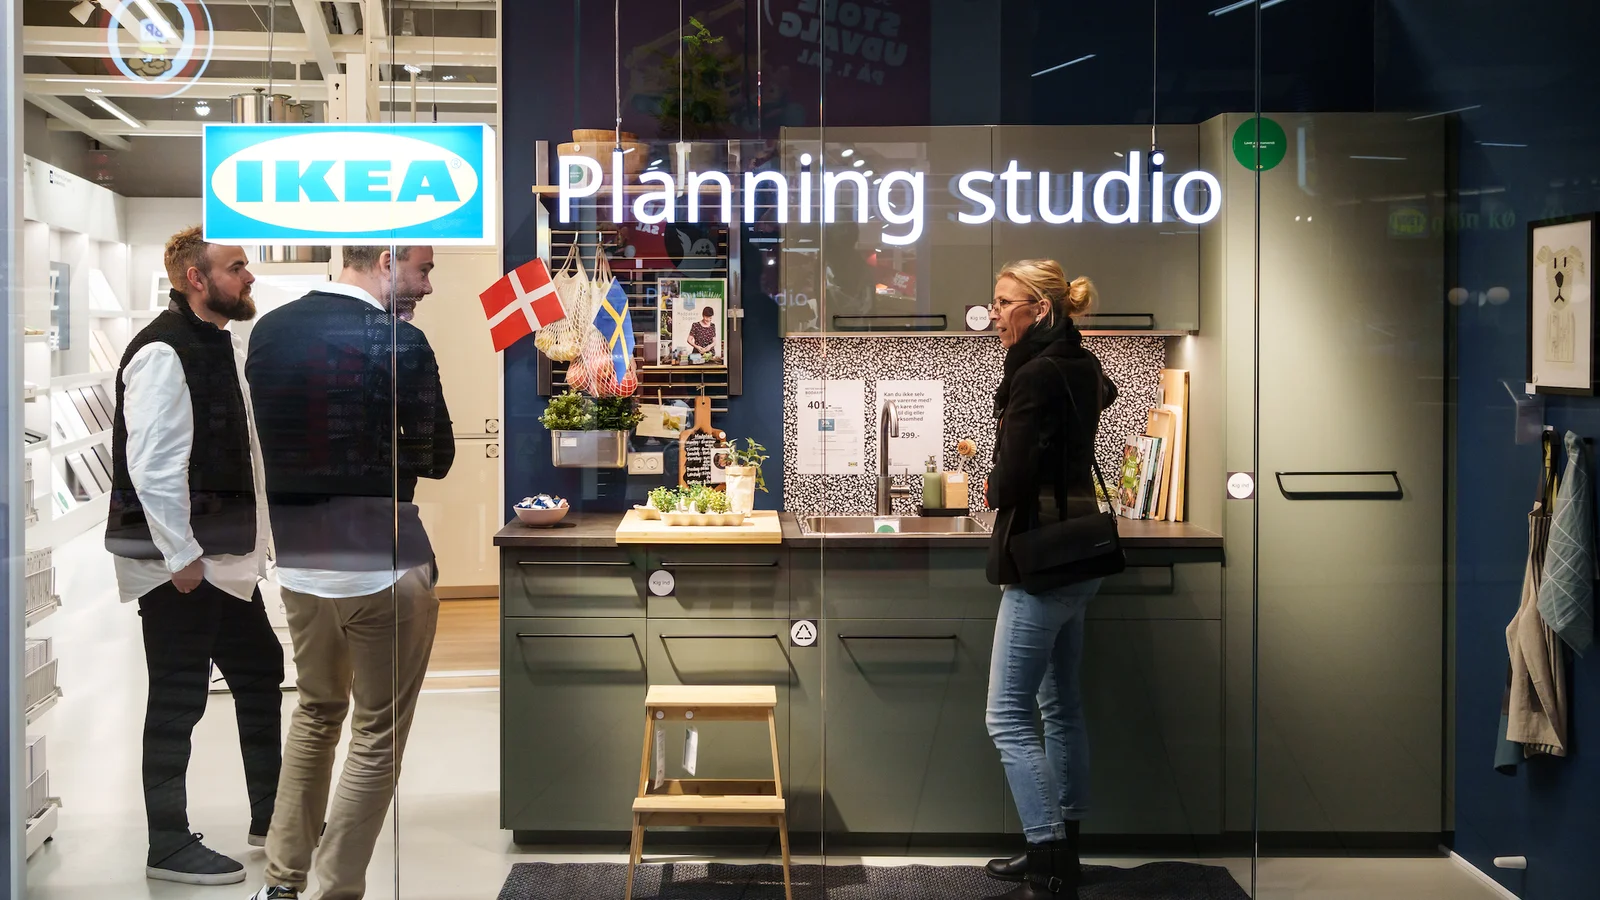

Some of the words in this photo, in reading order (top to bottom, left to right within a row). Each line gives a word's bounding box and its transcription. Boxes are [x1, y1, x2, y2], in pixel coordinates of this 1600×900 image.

[236, 160, 461, 203] IKEA
[557, 151, 925, 246] Planning
[958, 150, 1222, 224] studio
